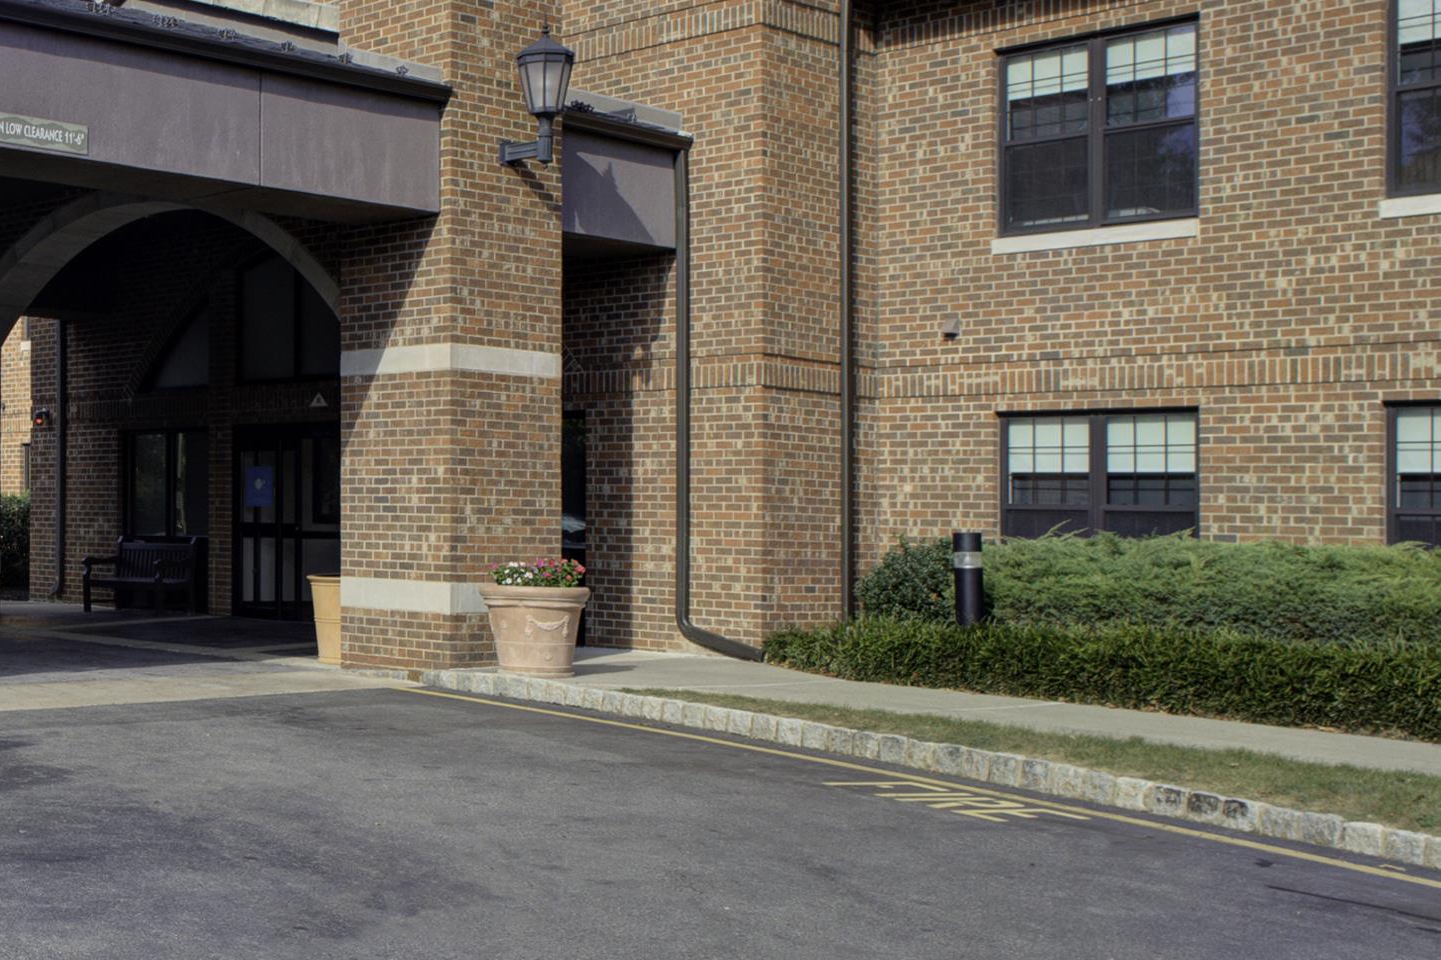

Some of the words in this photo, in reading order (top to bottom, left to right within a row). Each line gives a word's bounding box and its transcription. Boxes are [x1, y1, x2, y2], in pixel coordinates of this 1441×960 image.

[5, 121, 24, 136] LOW
[23, 125, 63, 143] CLEARANCE
[822, 781, 1091, 822] FIRE
